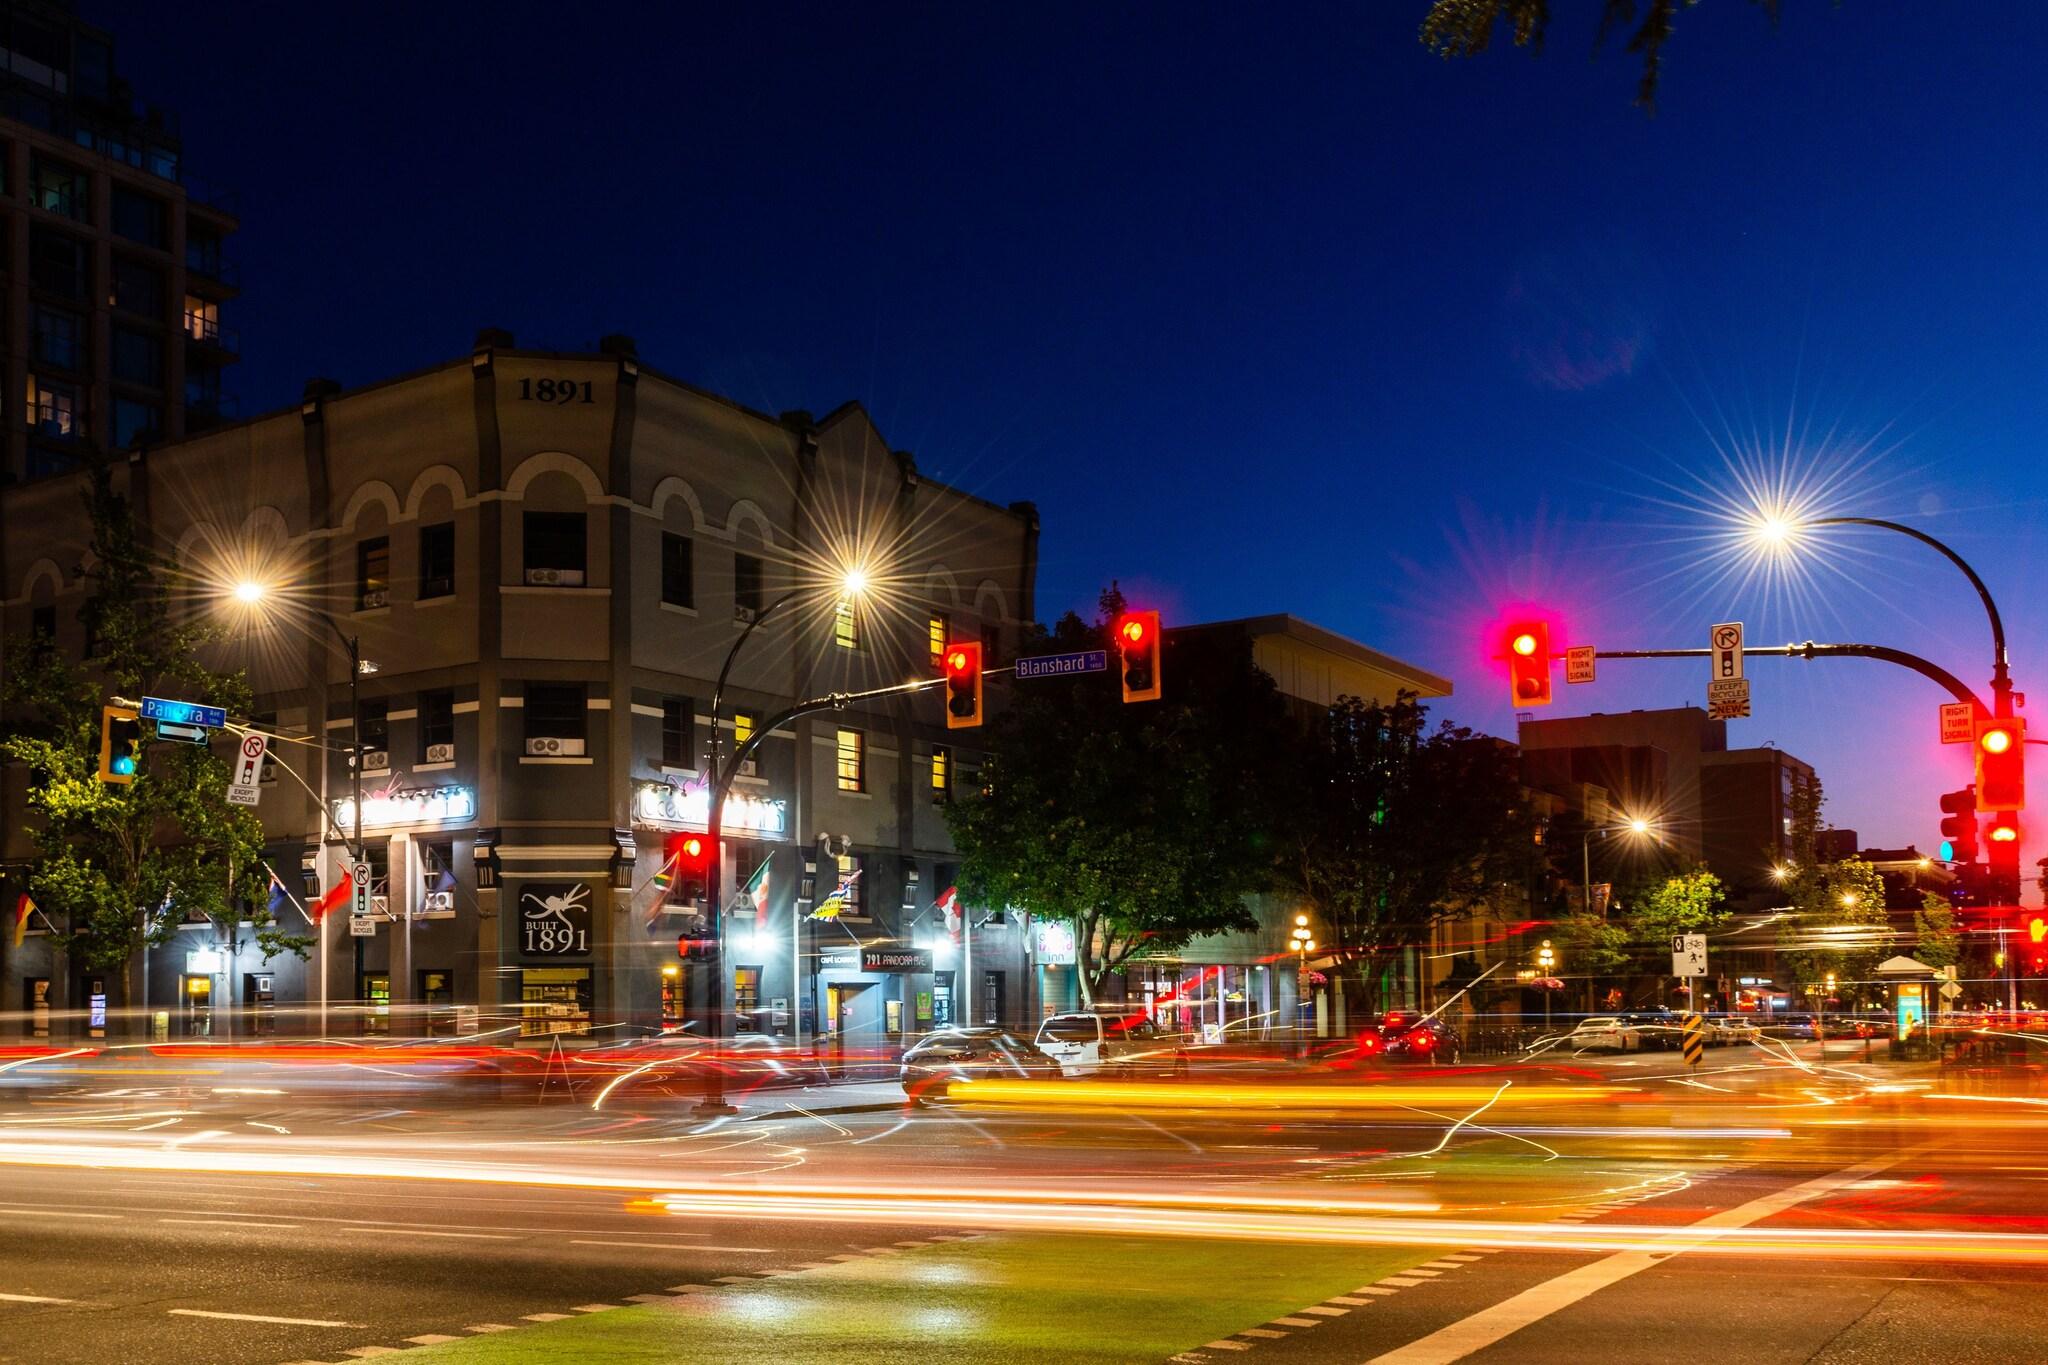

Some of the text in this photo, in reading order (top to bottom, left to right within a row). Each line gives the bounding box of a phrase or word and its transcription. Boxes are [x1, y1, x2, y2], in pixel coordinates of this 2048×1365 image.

[518, 378, 595, 405] 1891
[1570, 649, 1590, 659] RIGHT
[1021, 655, 1085, 675] Blanshard
[1572, 661, 1590, 669] TURN
[1569, 671, 1592, 680] SIGNAL
[1714, 681, 1742, 691] EXCEPT
[1710, 689, 1747, 699] BICYCLES
[147, 701, 203, 722] Panora
[1717, 704, 1742, 714] NEW
[1945, 706, 1969, 716] RIGHT
[1947, 718, 1969, 728] TURN
[1944, 730, 1971, 740] SIGNAL
[233, 788, 254, 796] EXCEPT
[230, 795, 255, 803] BICYCLES
[526, 921, 558, 930] BUILT
[525, 929, 588, 953] 1891
[866, 954, 881, 966] 791
[882, 955, 912, 966] PANDORA
